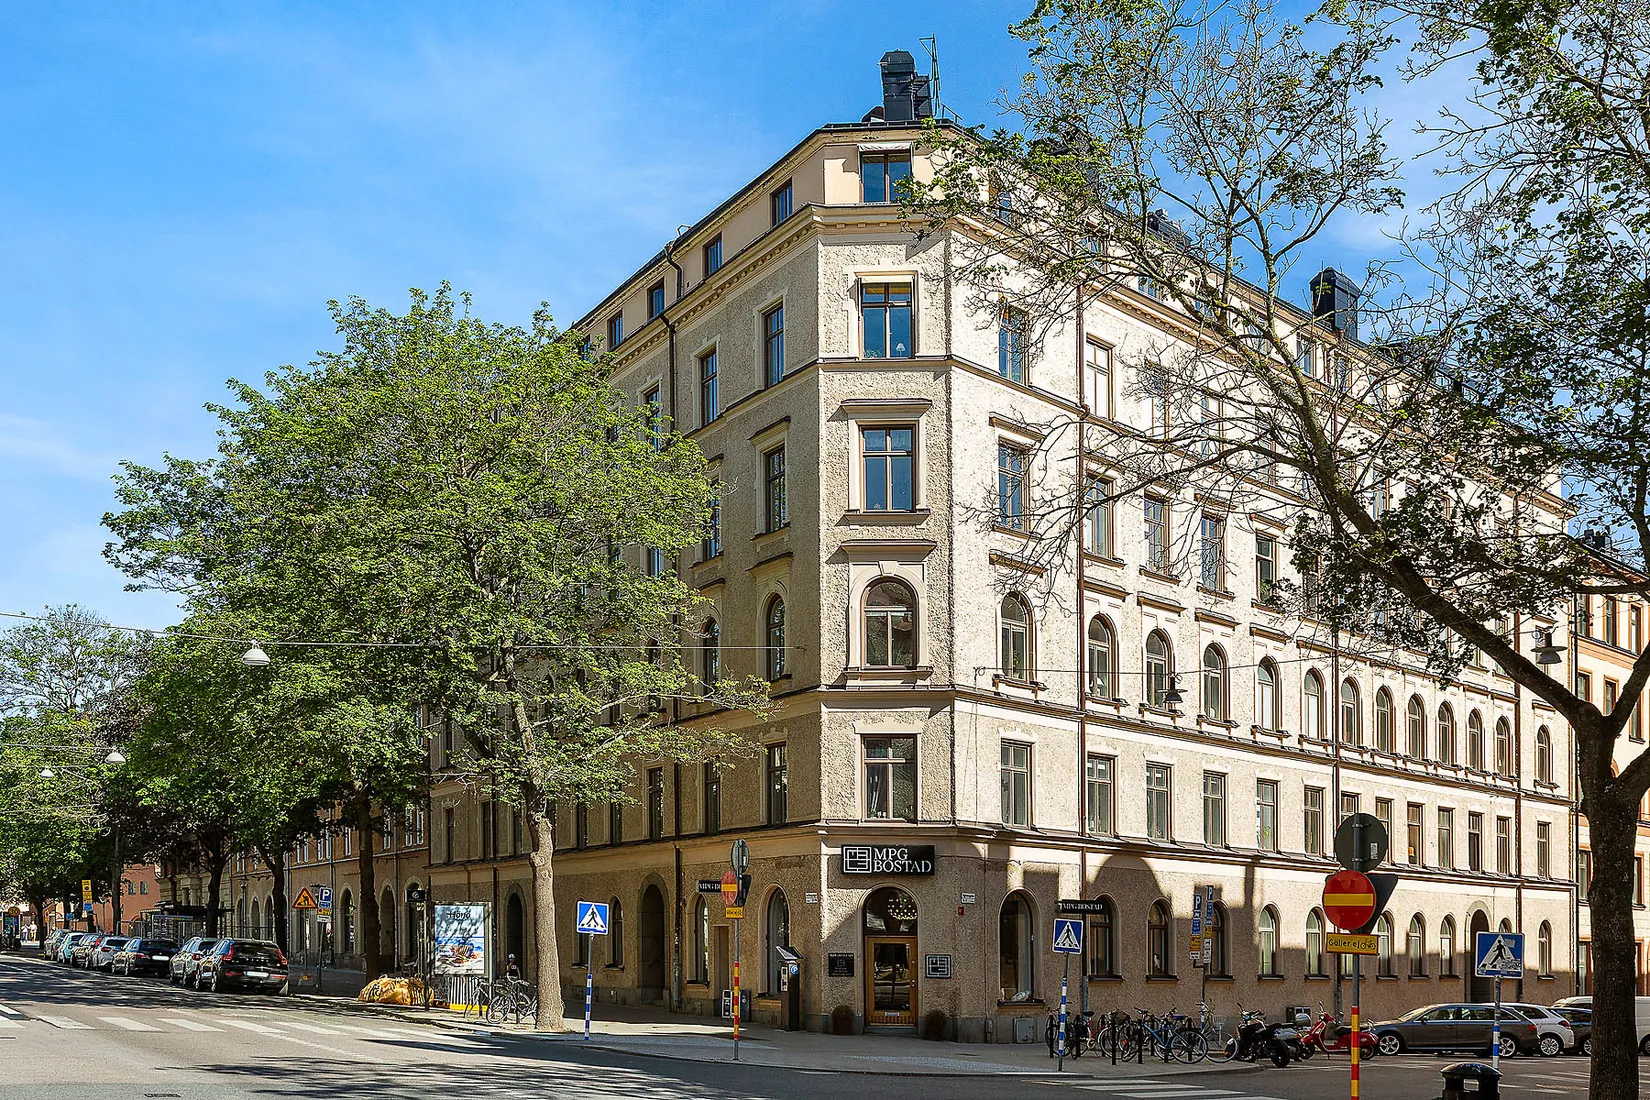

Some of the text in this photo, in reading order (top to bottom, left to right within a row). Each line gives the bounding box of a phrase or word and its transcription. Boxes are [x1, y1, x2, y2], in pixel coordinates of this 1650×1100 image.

[873, 848, 909, 860] MPG
[873, 860, 932, 873] BOSTAD
[322, 890, 330, 900] P
[1208, 886, 1213, 900] P
[1195, 896, 1201, 910] P
[1352, 939, 1360, 949] ej
